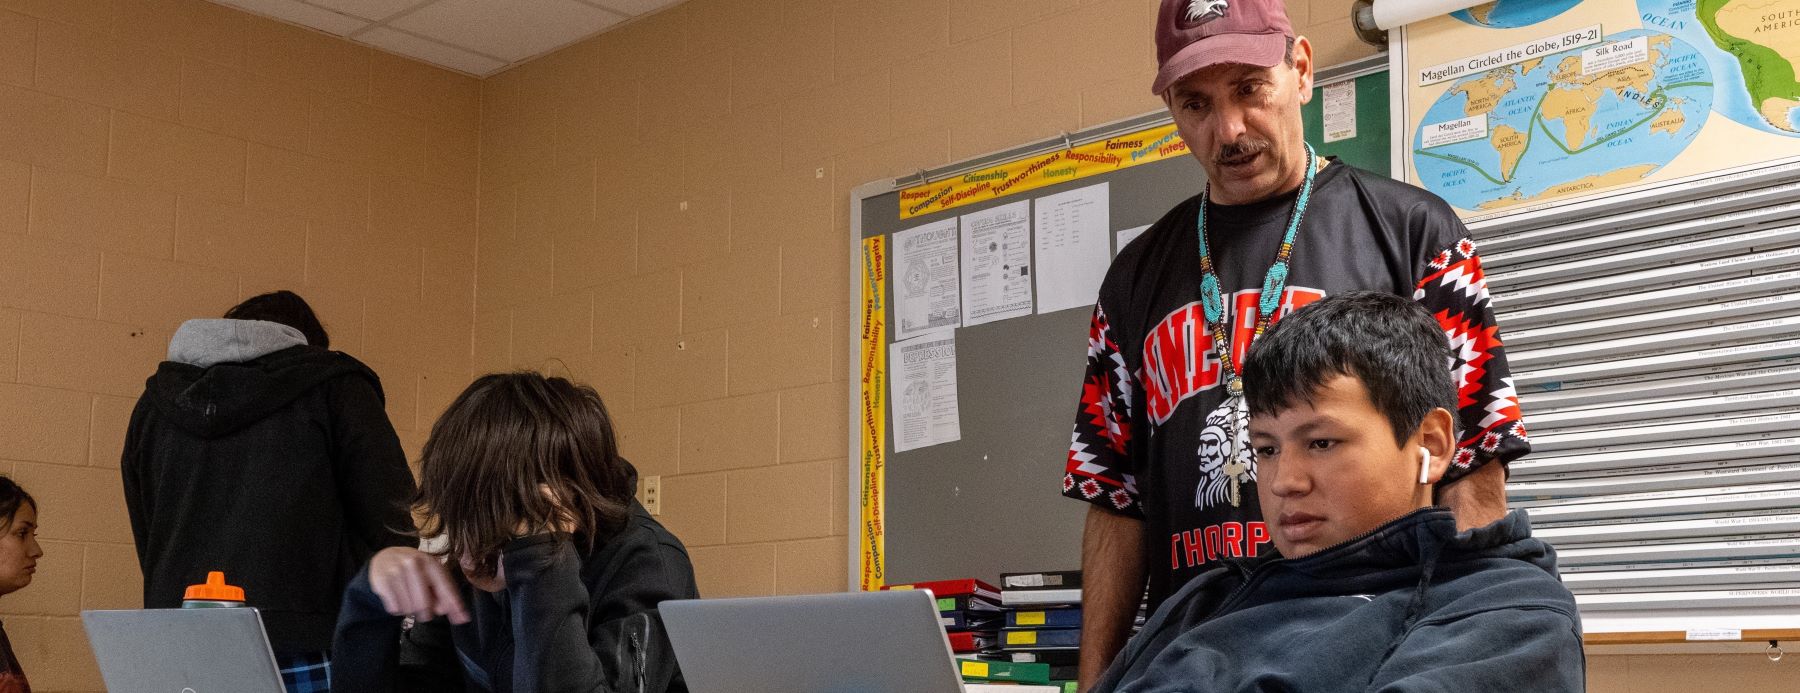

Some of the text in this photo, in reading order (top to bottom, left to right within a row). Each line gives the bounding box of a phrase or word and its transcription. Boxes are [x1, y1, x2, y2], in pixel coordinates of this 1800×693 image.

[1642, 12, 1687, 30] OCEAN
[1595, 41, 1633, 57] Silk Road
[1421, 64, 1465, 81] Magellan
[1468, 54, 1503, 70] Circled
[1506, 50, 1522, 61] the
[1526, 40, 1560, 56] Globe,
[1555, 70, 1577, 80] EUROPE
[1468, 101, 1492, 112] AMERICA
[1470, 96, 1490, 106] NORTH
[1503, 94, 1536, 108] ATLANTIC
[1618, 89, 1660, 109] INDIES
[1508, 105, 1533, 117] OCEAN
[1565, 106, 1586, 116] AFRICA
[1438, 120, 1471, 132] Magellan
[1606, 118, 1634, 130] INDIAN
[1650, 118, 1685, 128] AUSTRALIA
[1105, 139, 1144, 150] Fairness
[1497, 140, 1522, 150] AMERICA
[1500, 134, 1519, 143] SOUTH
[1607, 137, 1633, 148] OCEAN
[1065, 150, 1122, 167] Responsibility
[963, 169, 1008, 184] Citizenship
[991, 153, 1060, 197] Trustworthiness
[1043, 166, 1078, 179] Honesty
[1441, 168, 1466, 178] PACIFIC
[1443, 178, 1466, 188] OCEAN
[1556, 182, 1594, 194] ANTARCTICA
[901, 190, 931, 201] Respect
[909, 185, 953, 215] Compassion
[940, 181, 991, 208] Self-Discipline
[872, 238, 883, 282] Integrity
[863, 244, 882, 311] Perseverance
[862, 299, 873, 340] Fairness
[863, 319, 883, 384] Responsibility
[873, 369, 883, 409] Honesty
[863, 390, 883, 471] Trustworthiness
[863, 449, 873, 507] Citizenship
[870, 471, 882, 537] Self-Discipline
[866, 520, 882, 579] Compassion
[862, 551, 872, 592] Respect
